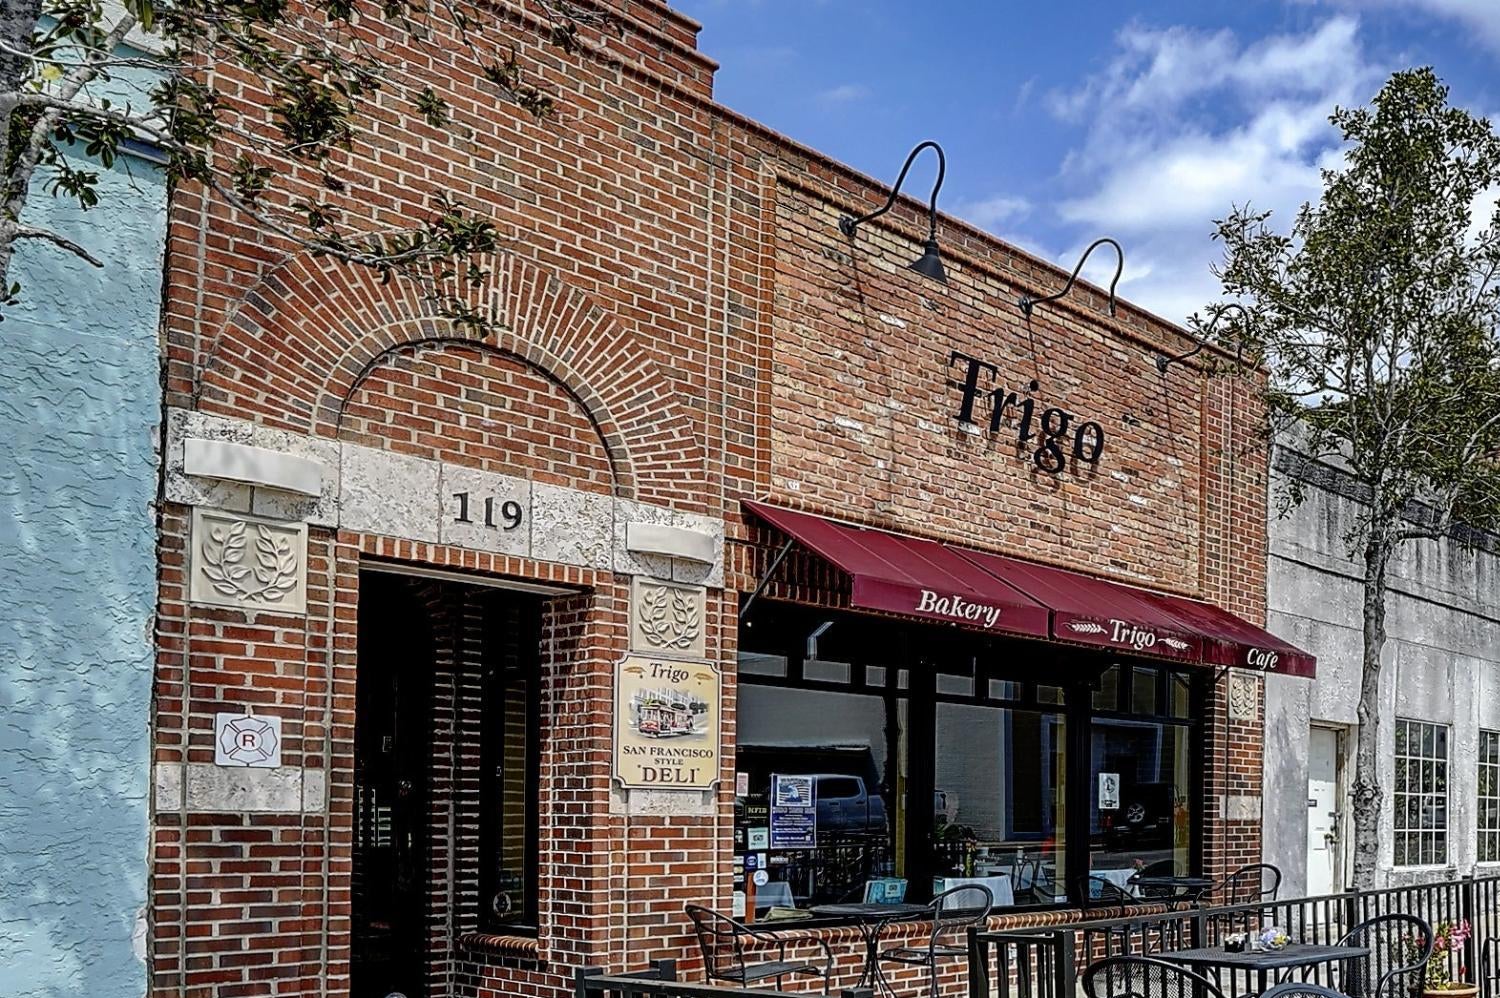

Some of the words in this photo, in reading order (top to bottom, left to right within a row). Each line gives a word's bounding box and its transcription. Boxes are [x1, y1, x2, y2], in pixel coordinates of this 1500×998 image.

[951, 351, 1104, 474] Trigo
[453, 492, 523, 530] 119
[915, 589, 1001, 628] Bakery
[1110, 619, 1156, 650] Trigo
[649, 662, 689, 683] Trigo
[1247, 648, 1279, 671] Cafe
[242, 734, 255, 747] R
[623, 745, 646, 755] SAN
[650, 747, 714, 759] FRANCISCO
